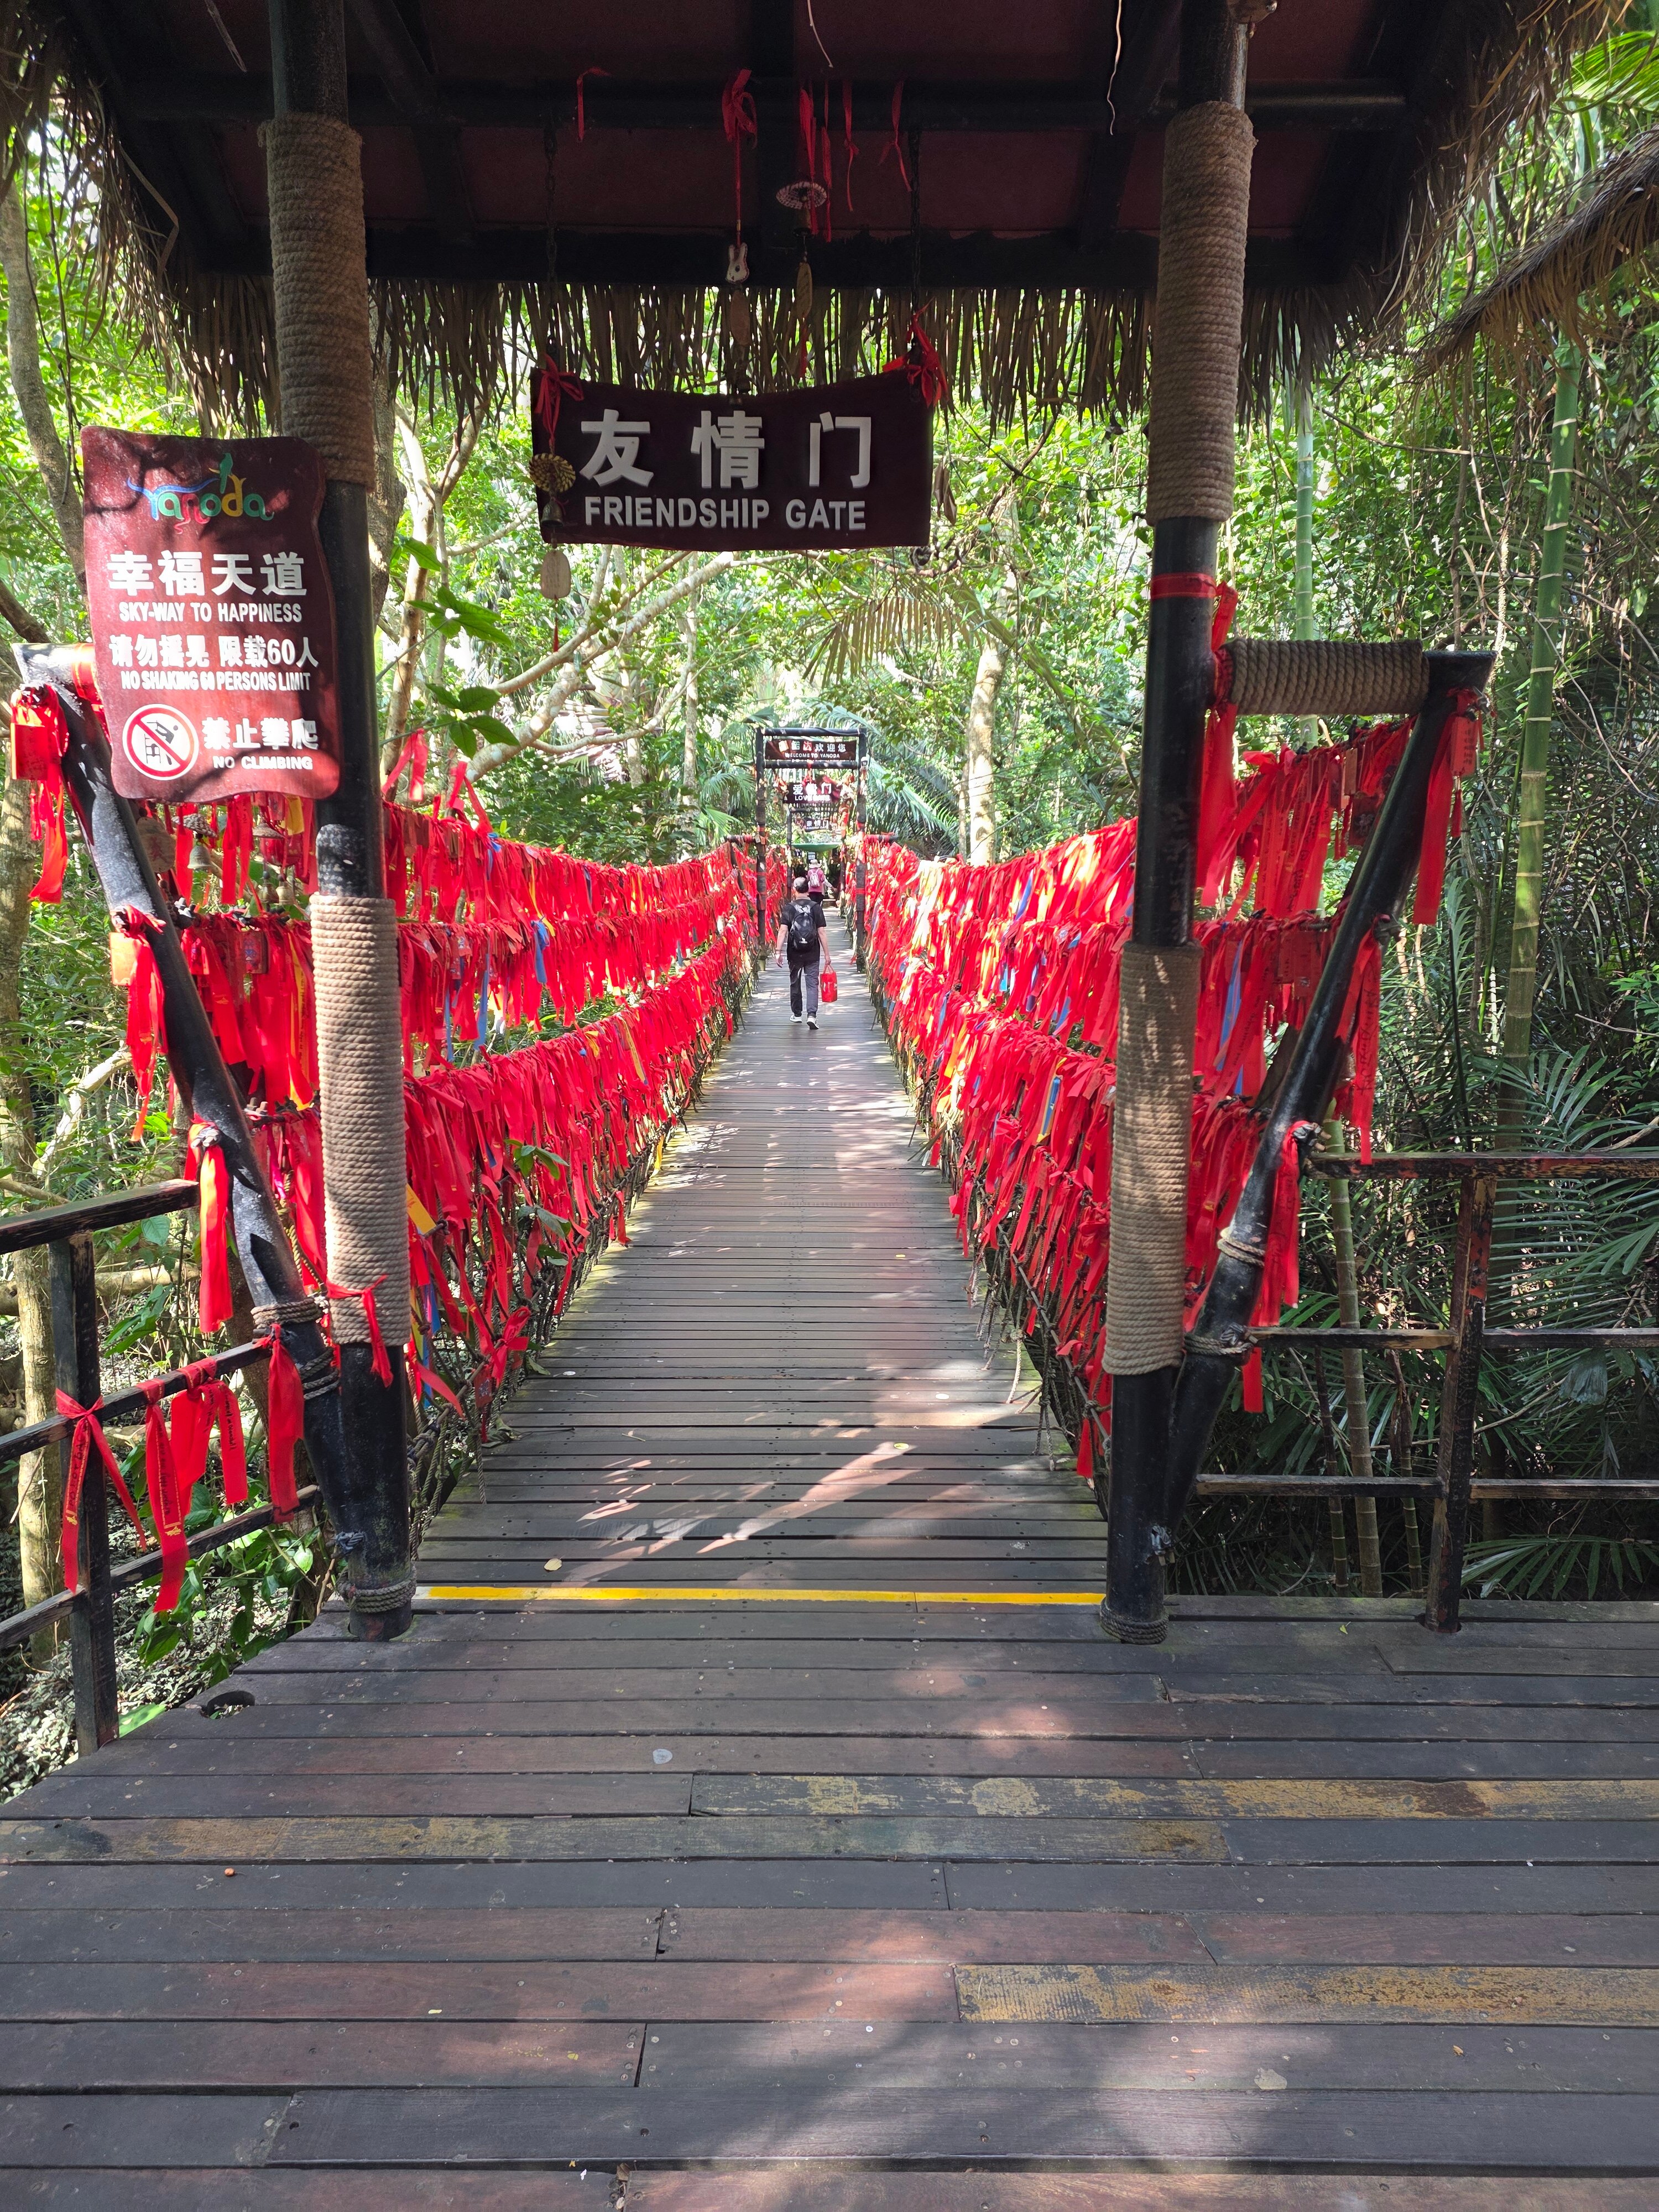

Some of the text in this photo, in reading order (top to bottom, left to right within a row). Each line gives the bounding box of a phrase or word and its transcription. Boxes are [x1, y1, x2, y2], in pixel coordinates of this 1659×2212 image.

[580, 409, 872, 489] 友情门
[585, 495, 867, 531] FRIENDSHIP GATE
[107, 550, 307, 596] 幸福天道
[119, 602, 302, 623] SKY-WAY TO HAPPINESS
[109, 634, 319, 668] 请勿摇晃 限载60人
[121, 671, 311, 691] NO SHAKING 60 PERSONS LIMIT
[201, 717, 319, 750] 禁止攀爬
[779, 740, 846, 753] 诺达欢迎您
[213, 756, 313, 770] NO CLIMBING
[793, 782, 832, 795] 爱门
